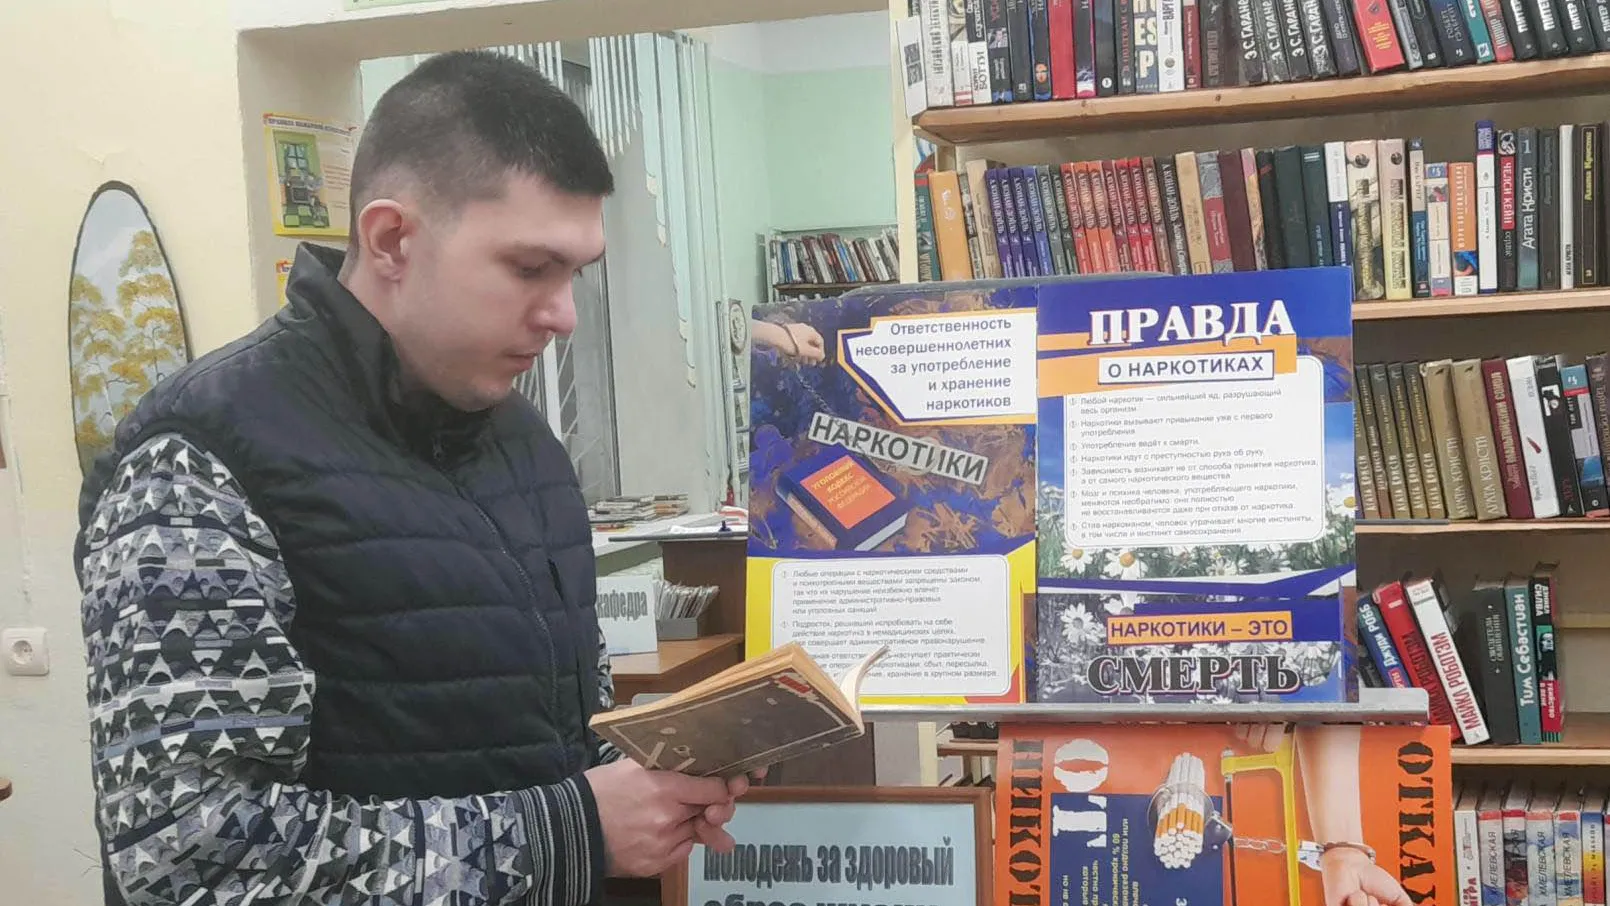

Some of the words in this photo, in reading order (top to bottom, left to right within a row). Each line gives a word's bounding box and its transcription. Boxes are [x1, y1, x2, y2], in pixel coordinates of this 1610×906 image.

[1502, 162, 1512, 195] ЧЕЛСИ
[1521, 167, 1535, 212] Кристи
[1503, 196, 1514, 224] КЕЙН
[1522, 213, 1536, 249] Агата
[890, 318, 1012, 336] Ответственность
[1088, 299, 1297, 346] ПРАВДА
[856, 338, 1012, 357] несовершеннолетних
[890, 363, 907, 375] за
[911, 357, 1011, 375] употребление
[1108, 363, 1121, 378] О
[1128, 356, 1264, 377] НАРКОТИКАХ
[928, 380, 937, 391] и
[941, 377, 1011, 393] хранение
[1491, 371, 1505, 400] СОКОЛ
[926, 397, 1011, 413] наркотиков
[812, 415, 986, 482] НАРКОТИКИ
[1534, 583, 1544, 617] СИЛВА
[1111, 620, 1226, 638] НАРКОТИКИ
[1248, 619, 1288, 636] ЭТО
[1358, 602, 1379, 633] РОББ
[1514, 593, 1532, 675] Себастиан
[1374, 634, 1398, 668] Джуди
[1431, 631, 1465, 688] РОБОТЭМ
[1087, 654, 1300, 694] СМЕРТЬ
[1452, 687, 1482, 730] МАЙКЛ
[1520, 676, 1534, 707] Тим
[1052, 739, 1109, 849] ОТ
[817, 845, 841, 884] за
[845, 836, 954, 891] здоровый
[1488, 831, 1498, 895] ХМЕЛЕВСКАЯ
[1537, 831, 1547, 895] ХМЕЛЕВСКАЯ
[1563, 832, 1574, 896] ХМЕЛЕВСКАЯ
